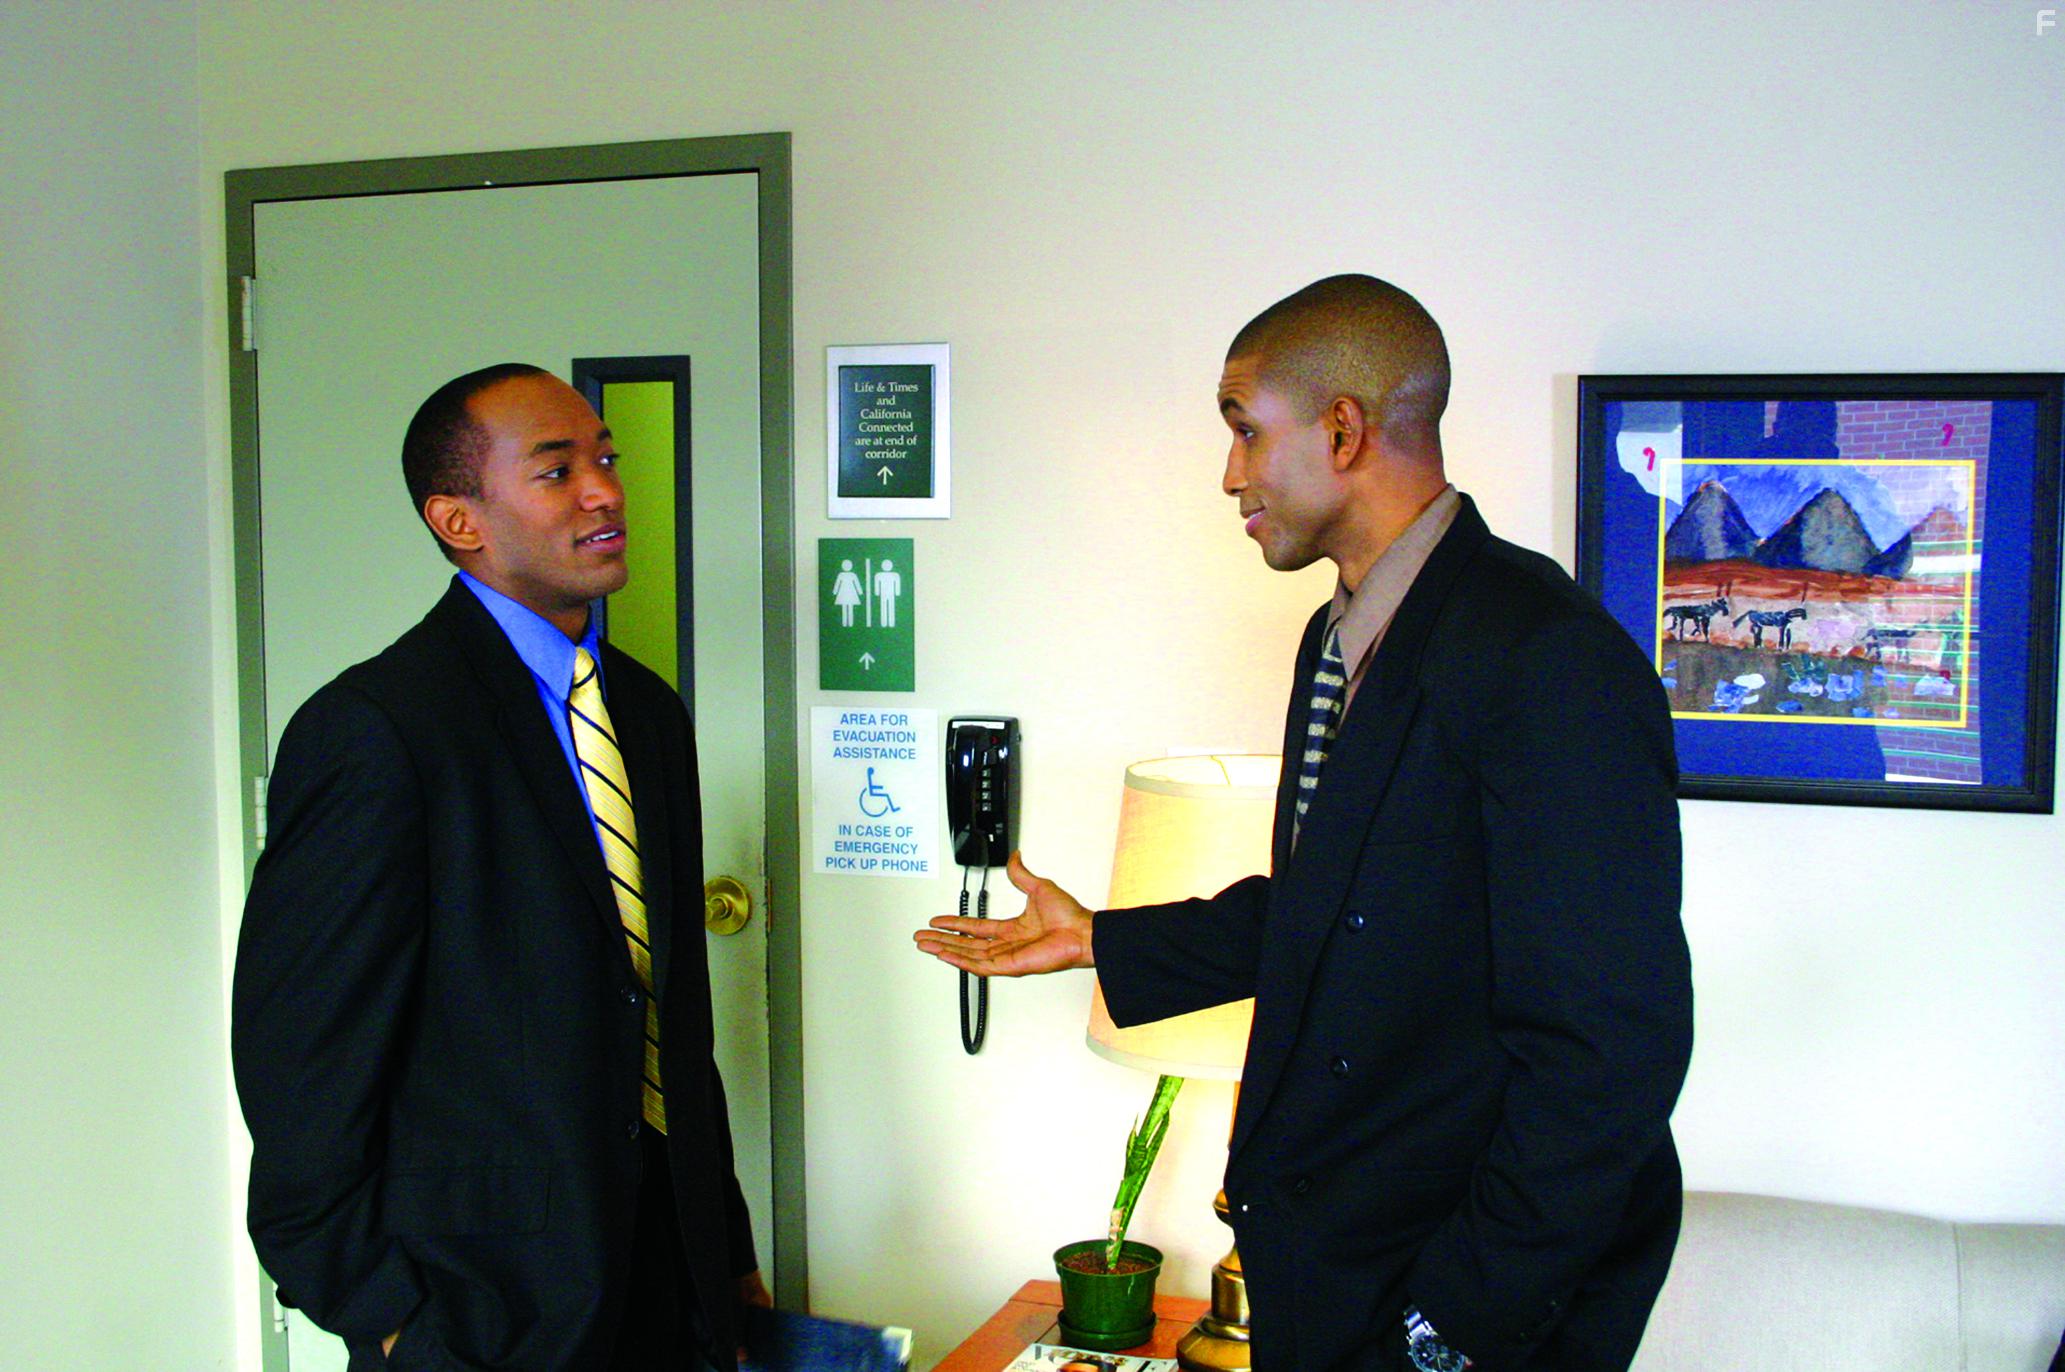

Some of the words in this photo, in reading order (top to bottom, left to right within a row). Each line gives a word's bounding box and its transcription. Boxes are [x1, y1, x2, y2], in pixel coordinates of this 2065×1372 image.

[854, 382, 874, 392] Life
[876, 383, 886, 392] &
[888, 382, 918, 392] Times
[876, 396, 896, 405] and
[860, 408, 912, 420] California
[858, 422, 913, 433] Connected
[855, 438, 871, 446] are
[873, 436, 882, 446] at
[884, 436, 904, 446] end
[906, 435, 918, 446] of
[865, 449, 907, 460] corridor
[840, 714, 876, 725] AREA
[880, 714, 908, 726] FOR
[833, 730, 916, 742] EVACUATION
[833, 747, 916, 760] ASSISTANCE
[838, 824, 852, 836] IN
[856, 826, 890, 838] CASE
[895, 826, 914, 838] OF
[834, 841, 918, 855] EMERGENCY
[826, 857, 856, 870] PICK
[860, 858, 878, 870] UP
[882, 860, 928, 872] PHONE
